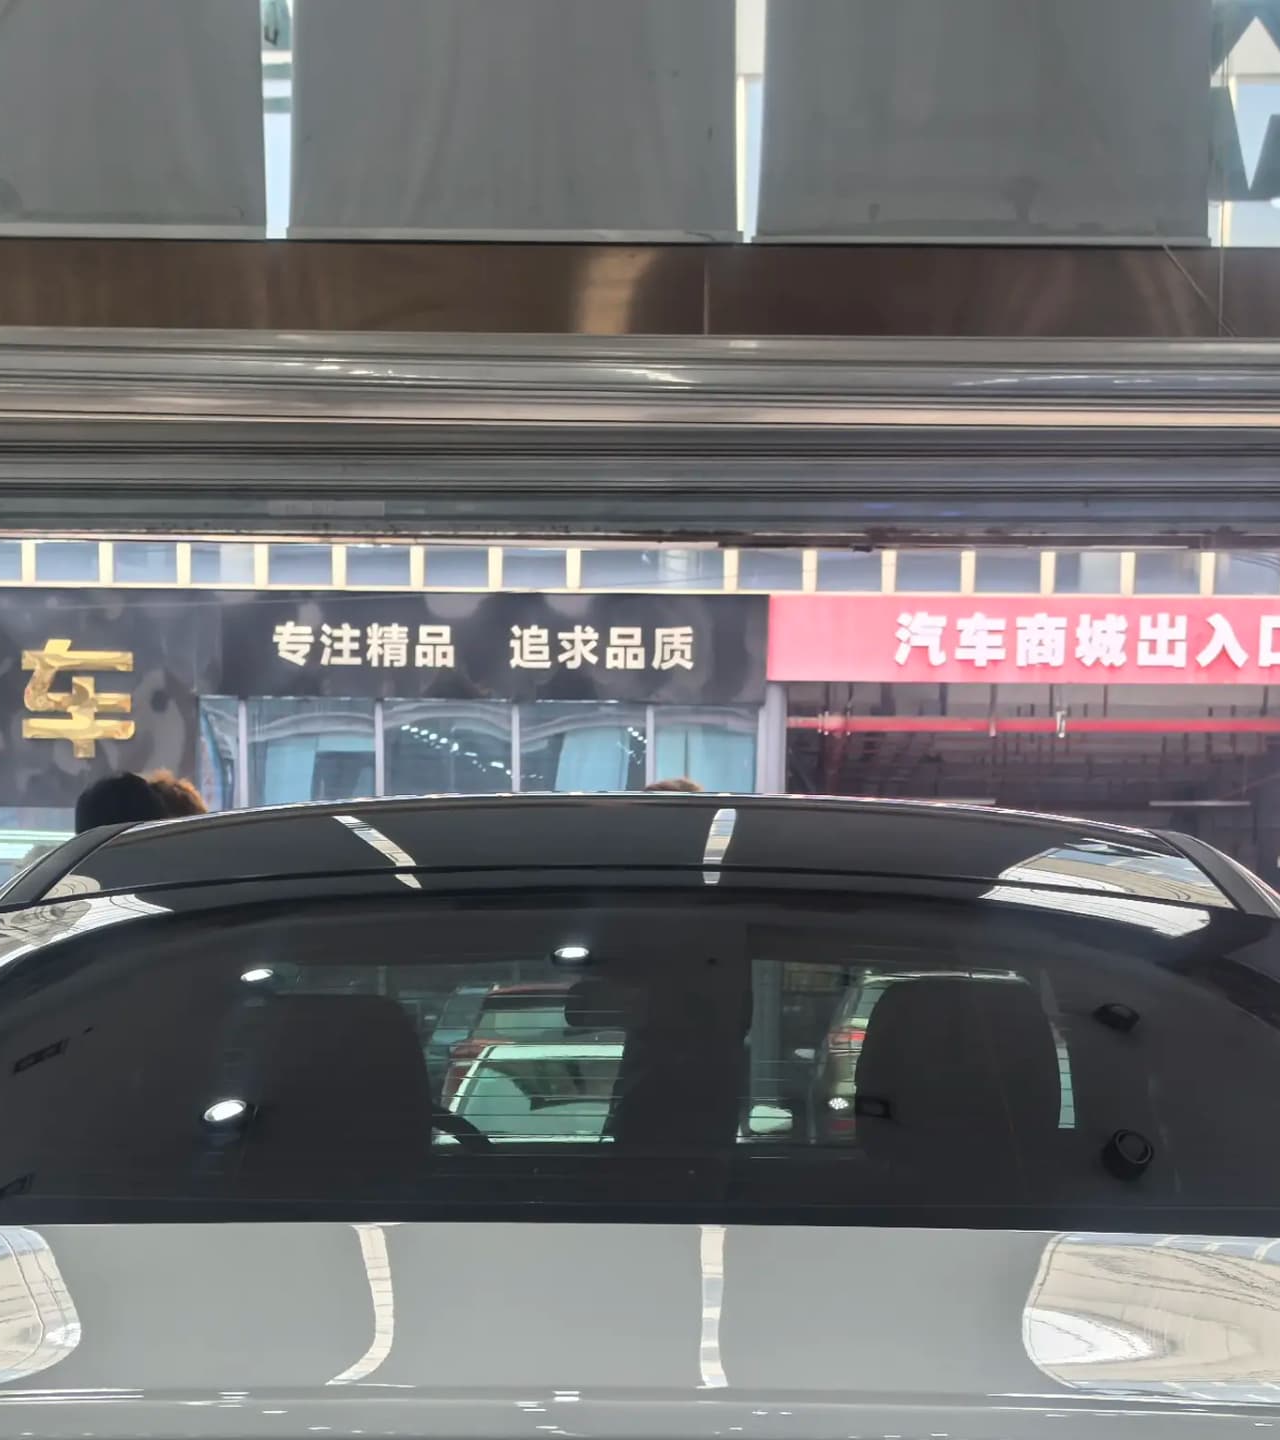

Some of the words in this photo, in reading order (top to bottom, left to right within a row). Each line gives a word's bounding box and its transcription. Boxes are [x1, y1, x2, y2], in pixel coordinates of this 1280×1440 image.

[272, 621, 456, 668] 专注精品
[509, 625, 695, 670] 追求品质
